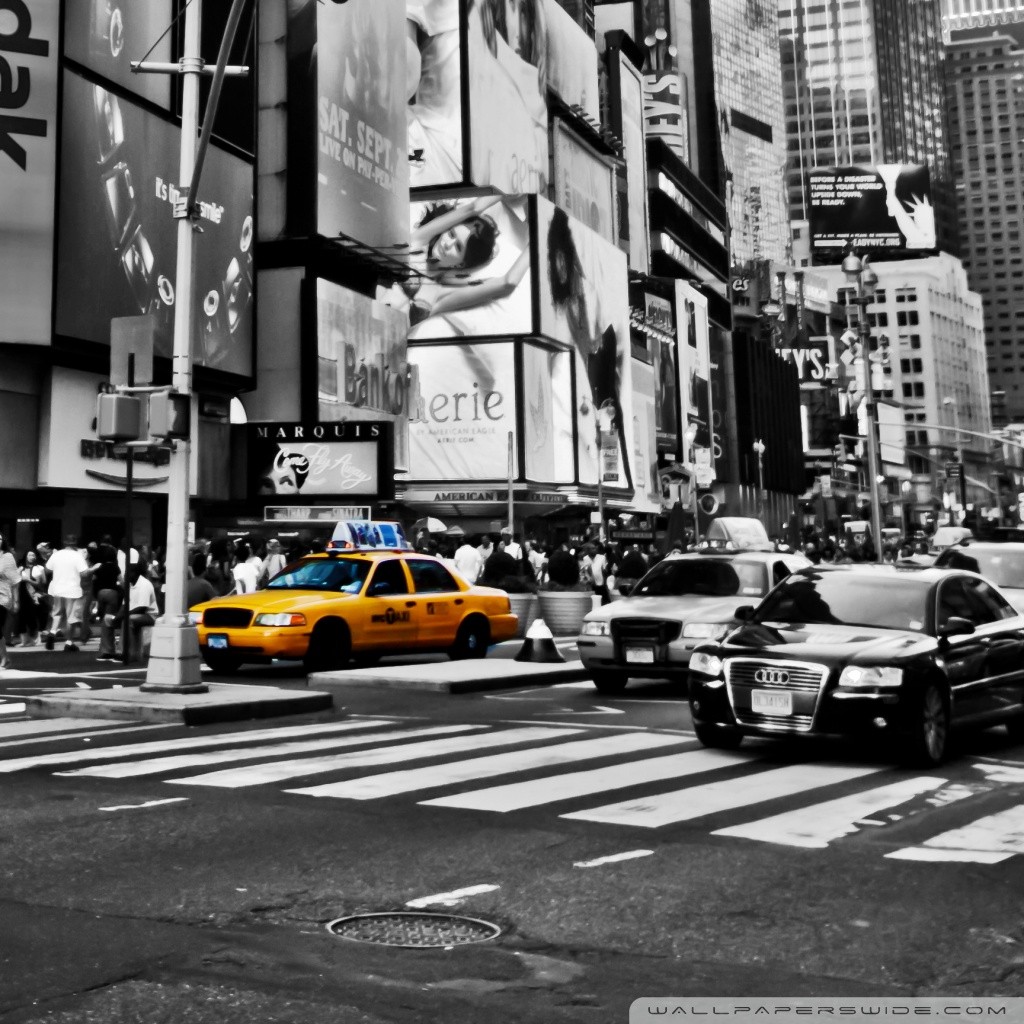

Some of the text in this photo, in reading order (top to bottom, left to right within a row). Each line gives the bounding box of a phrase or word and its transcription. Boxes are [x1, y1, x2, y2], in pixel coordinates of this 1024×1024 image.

[318, 96, 352, 146] SAT.
[319, 132, 341, 161] LIVE
[343, 147, 356, 170] ON
[257, 426, 379, 438] MARQUIS
[428, 427, 469, 436] AMERICAN
[434, 492, 493, 501] AMERICAN
